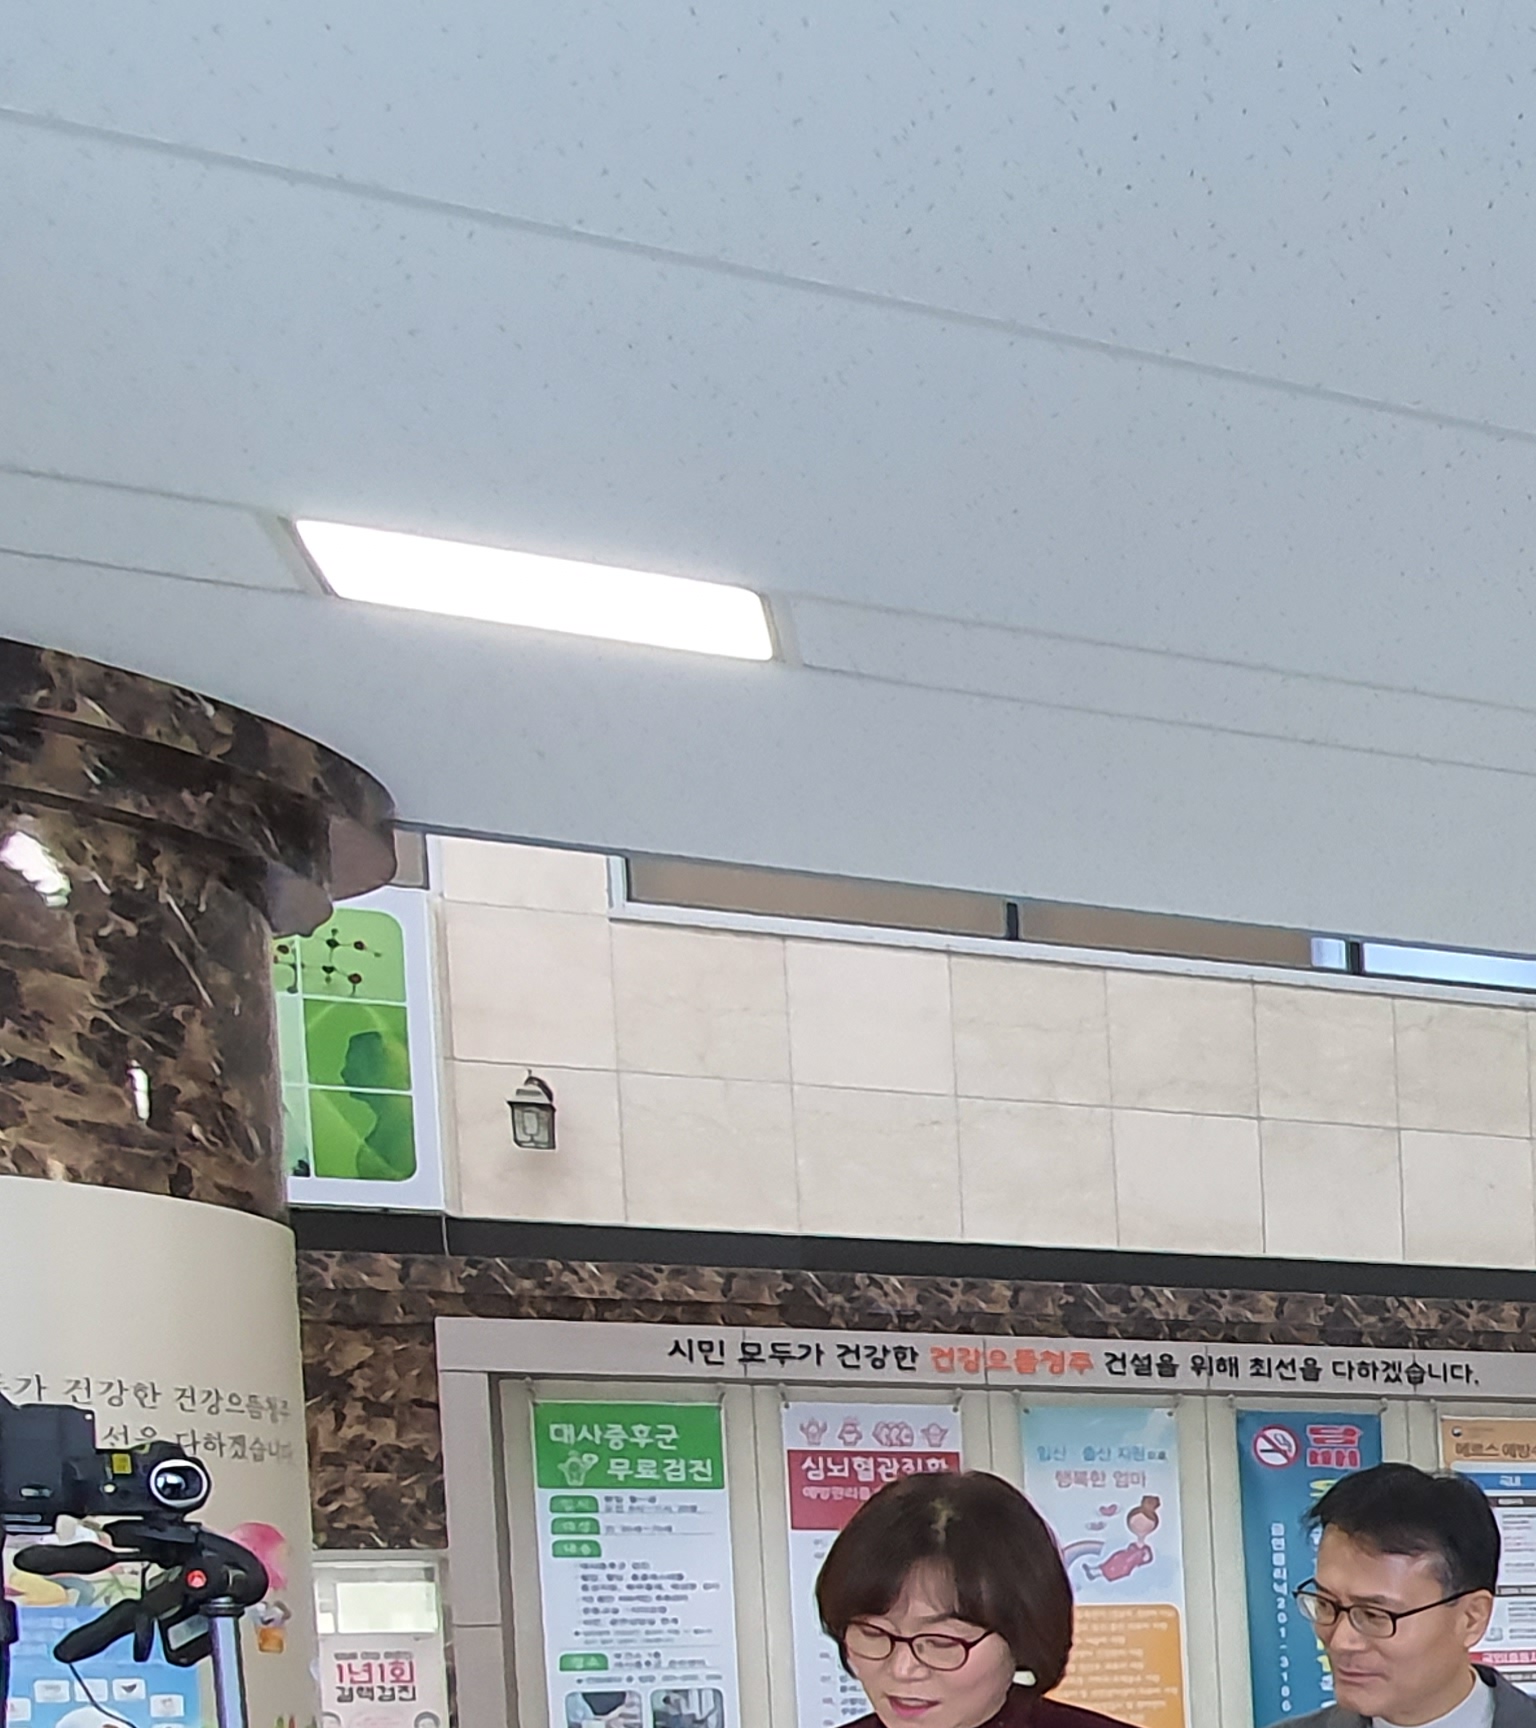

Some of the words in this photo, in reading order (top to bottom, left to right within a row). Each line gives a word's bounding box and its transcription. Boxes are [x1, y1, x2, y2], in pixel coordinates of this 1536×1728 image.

[667, 1338, 725, 1366] 시민
[738, 1340, 826, 1368] 모두가
[836, 1343, 919, 1371] 건강한
[1104, 1351, 1180, 1379] 건설을
[1190, 1354, 1240, 1380] 위해
[1249, 1355, 1323, 1383] 최선을
[1332, 1359, 1480, 1386] 다하겠습니다.
[64, 1376, 162, 1410] 건강한
[550, 1424, 679, 1450] 대사증후군
[607, 1457, 713, 1482] 무료검진
[1055, 1470, 1106, 1488] 행복한
[1113, 1470, 1146, 1488] 엄마
